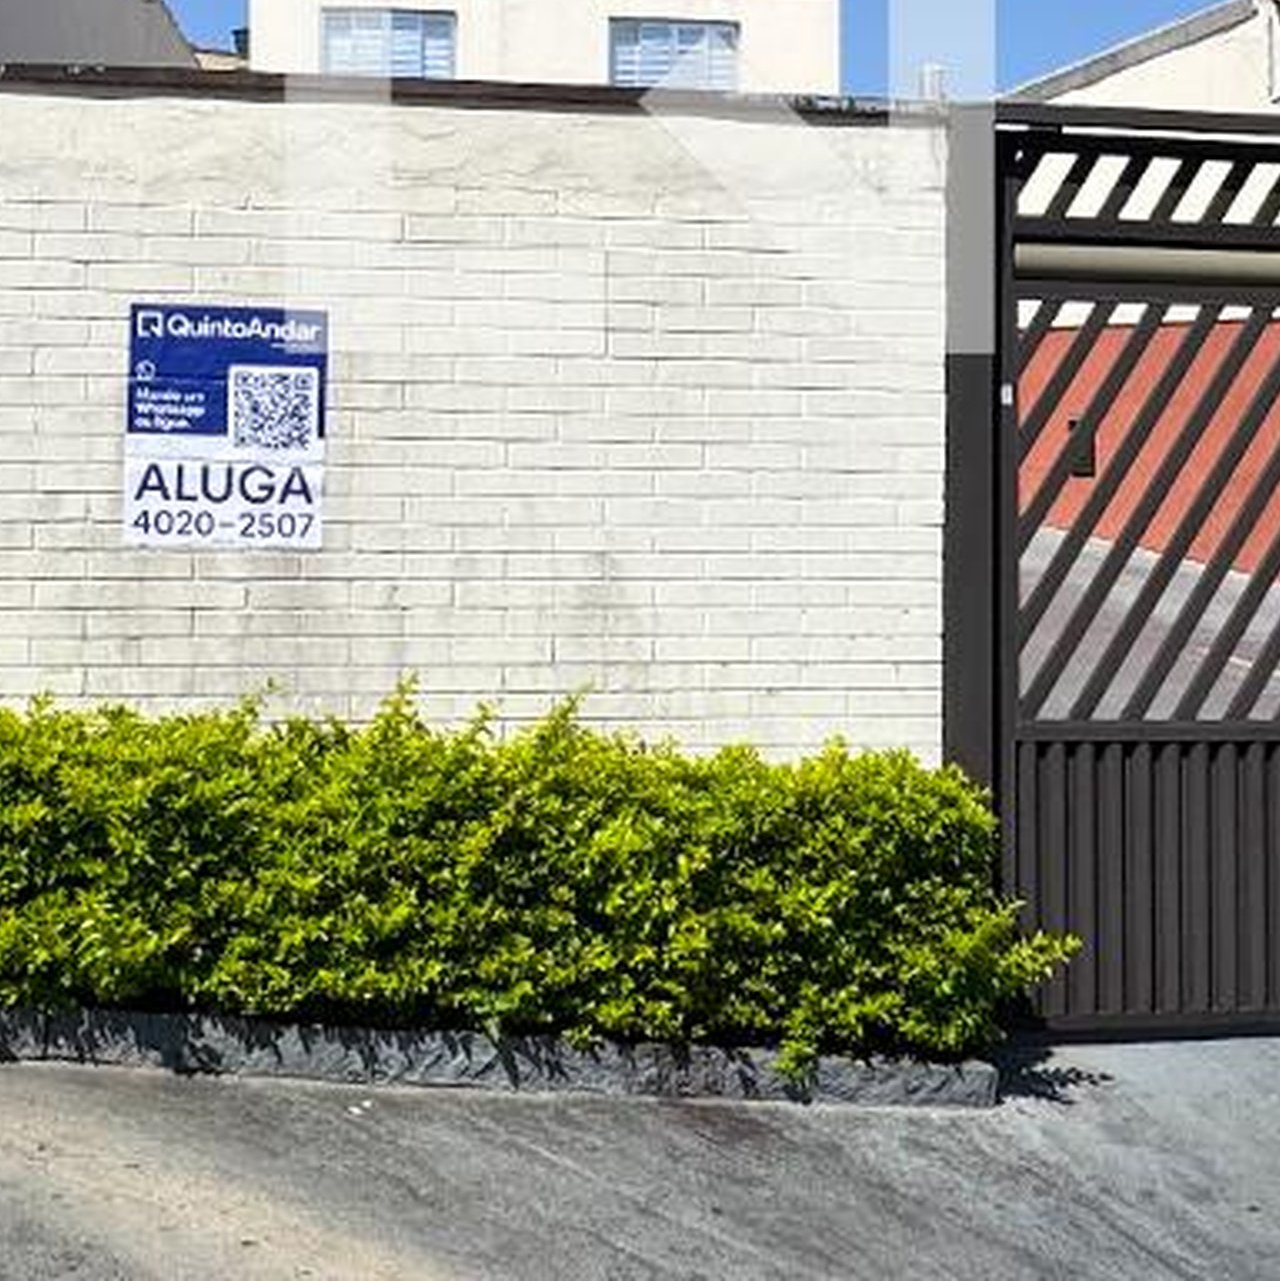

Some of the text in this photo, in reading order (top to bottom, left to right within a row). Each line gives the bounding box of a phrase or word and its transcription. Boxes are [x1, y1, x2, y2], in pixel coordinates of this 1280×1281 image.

[167, 314, 322, 341] QuintoAndar
[134, 463, 314, 505] ALUGA
[133, 510, 315, 538] 4020-2507
